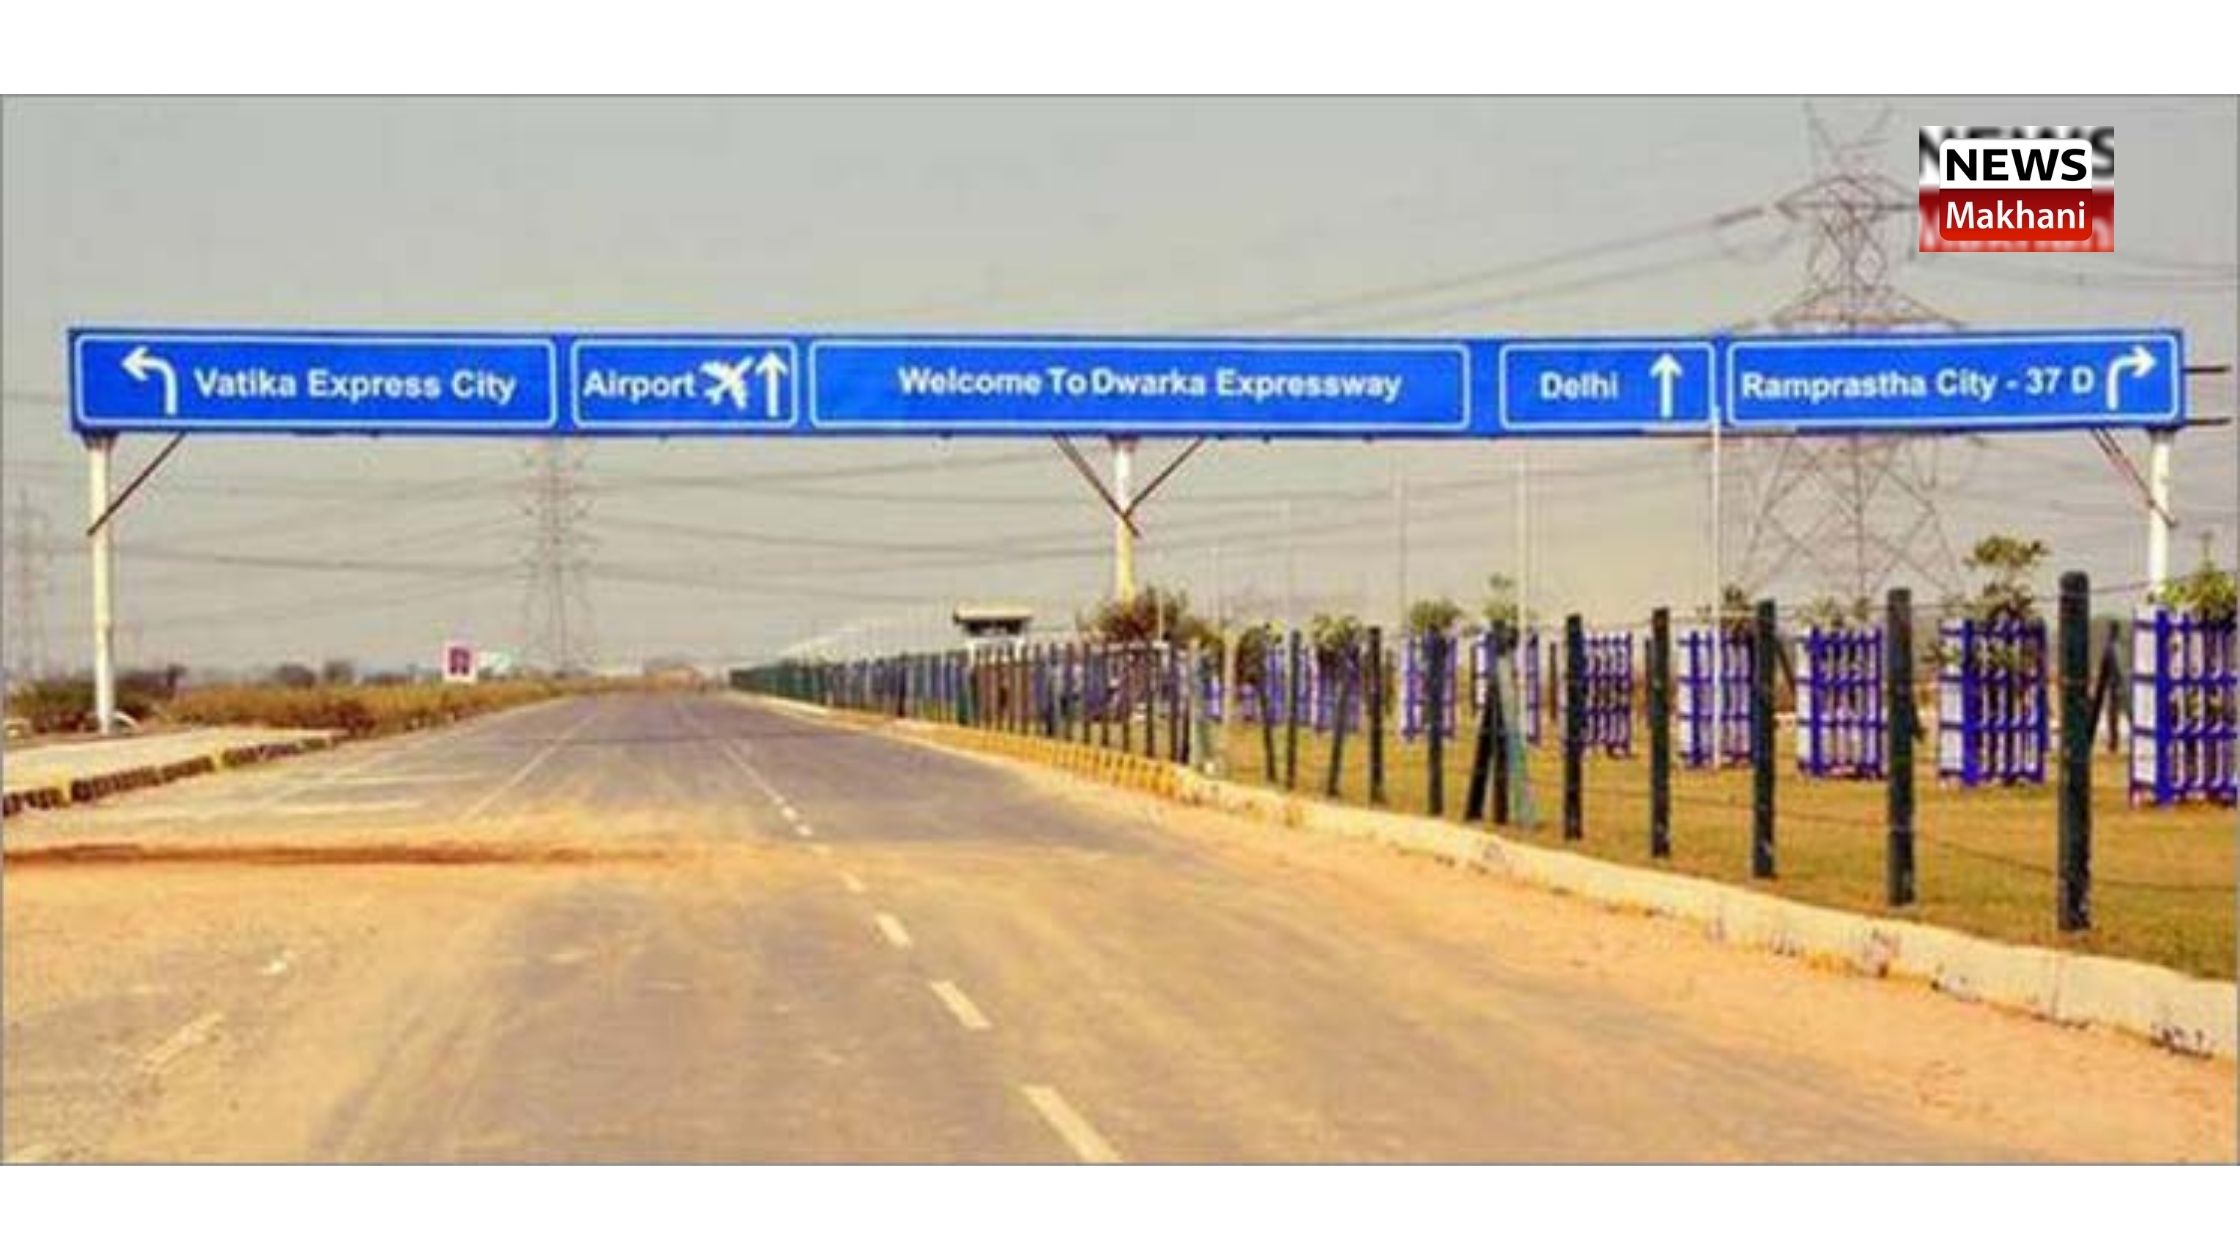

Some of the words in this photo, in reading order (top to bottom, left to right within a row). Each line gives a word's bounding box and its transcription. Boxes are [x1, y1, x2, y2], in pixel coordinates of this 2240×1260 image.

[195, 369, 296, 396] Vatika
[308, 369, 440, 402] Express
[452, 370, 515, 404] City
[584, 371, 695, 402] Airport
[899, 367, 1042, 394] Welcome
[1047, 368, 1087, 395] To
[1091, 368, 1207, 395] Dwarka
[1215, 369, 1401, 402] Expressway
[1541, 372, 1617, 399] Delhi
[1741, 372, 1927, 403] Ramprastha
[1936, 369, 1997, 401] City
[2027, 367, 2061, 394] 37
[2072, 366, 2094, 393] D
